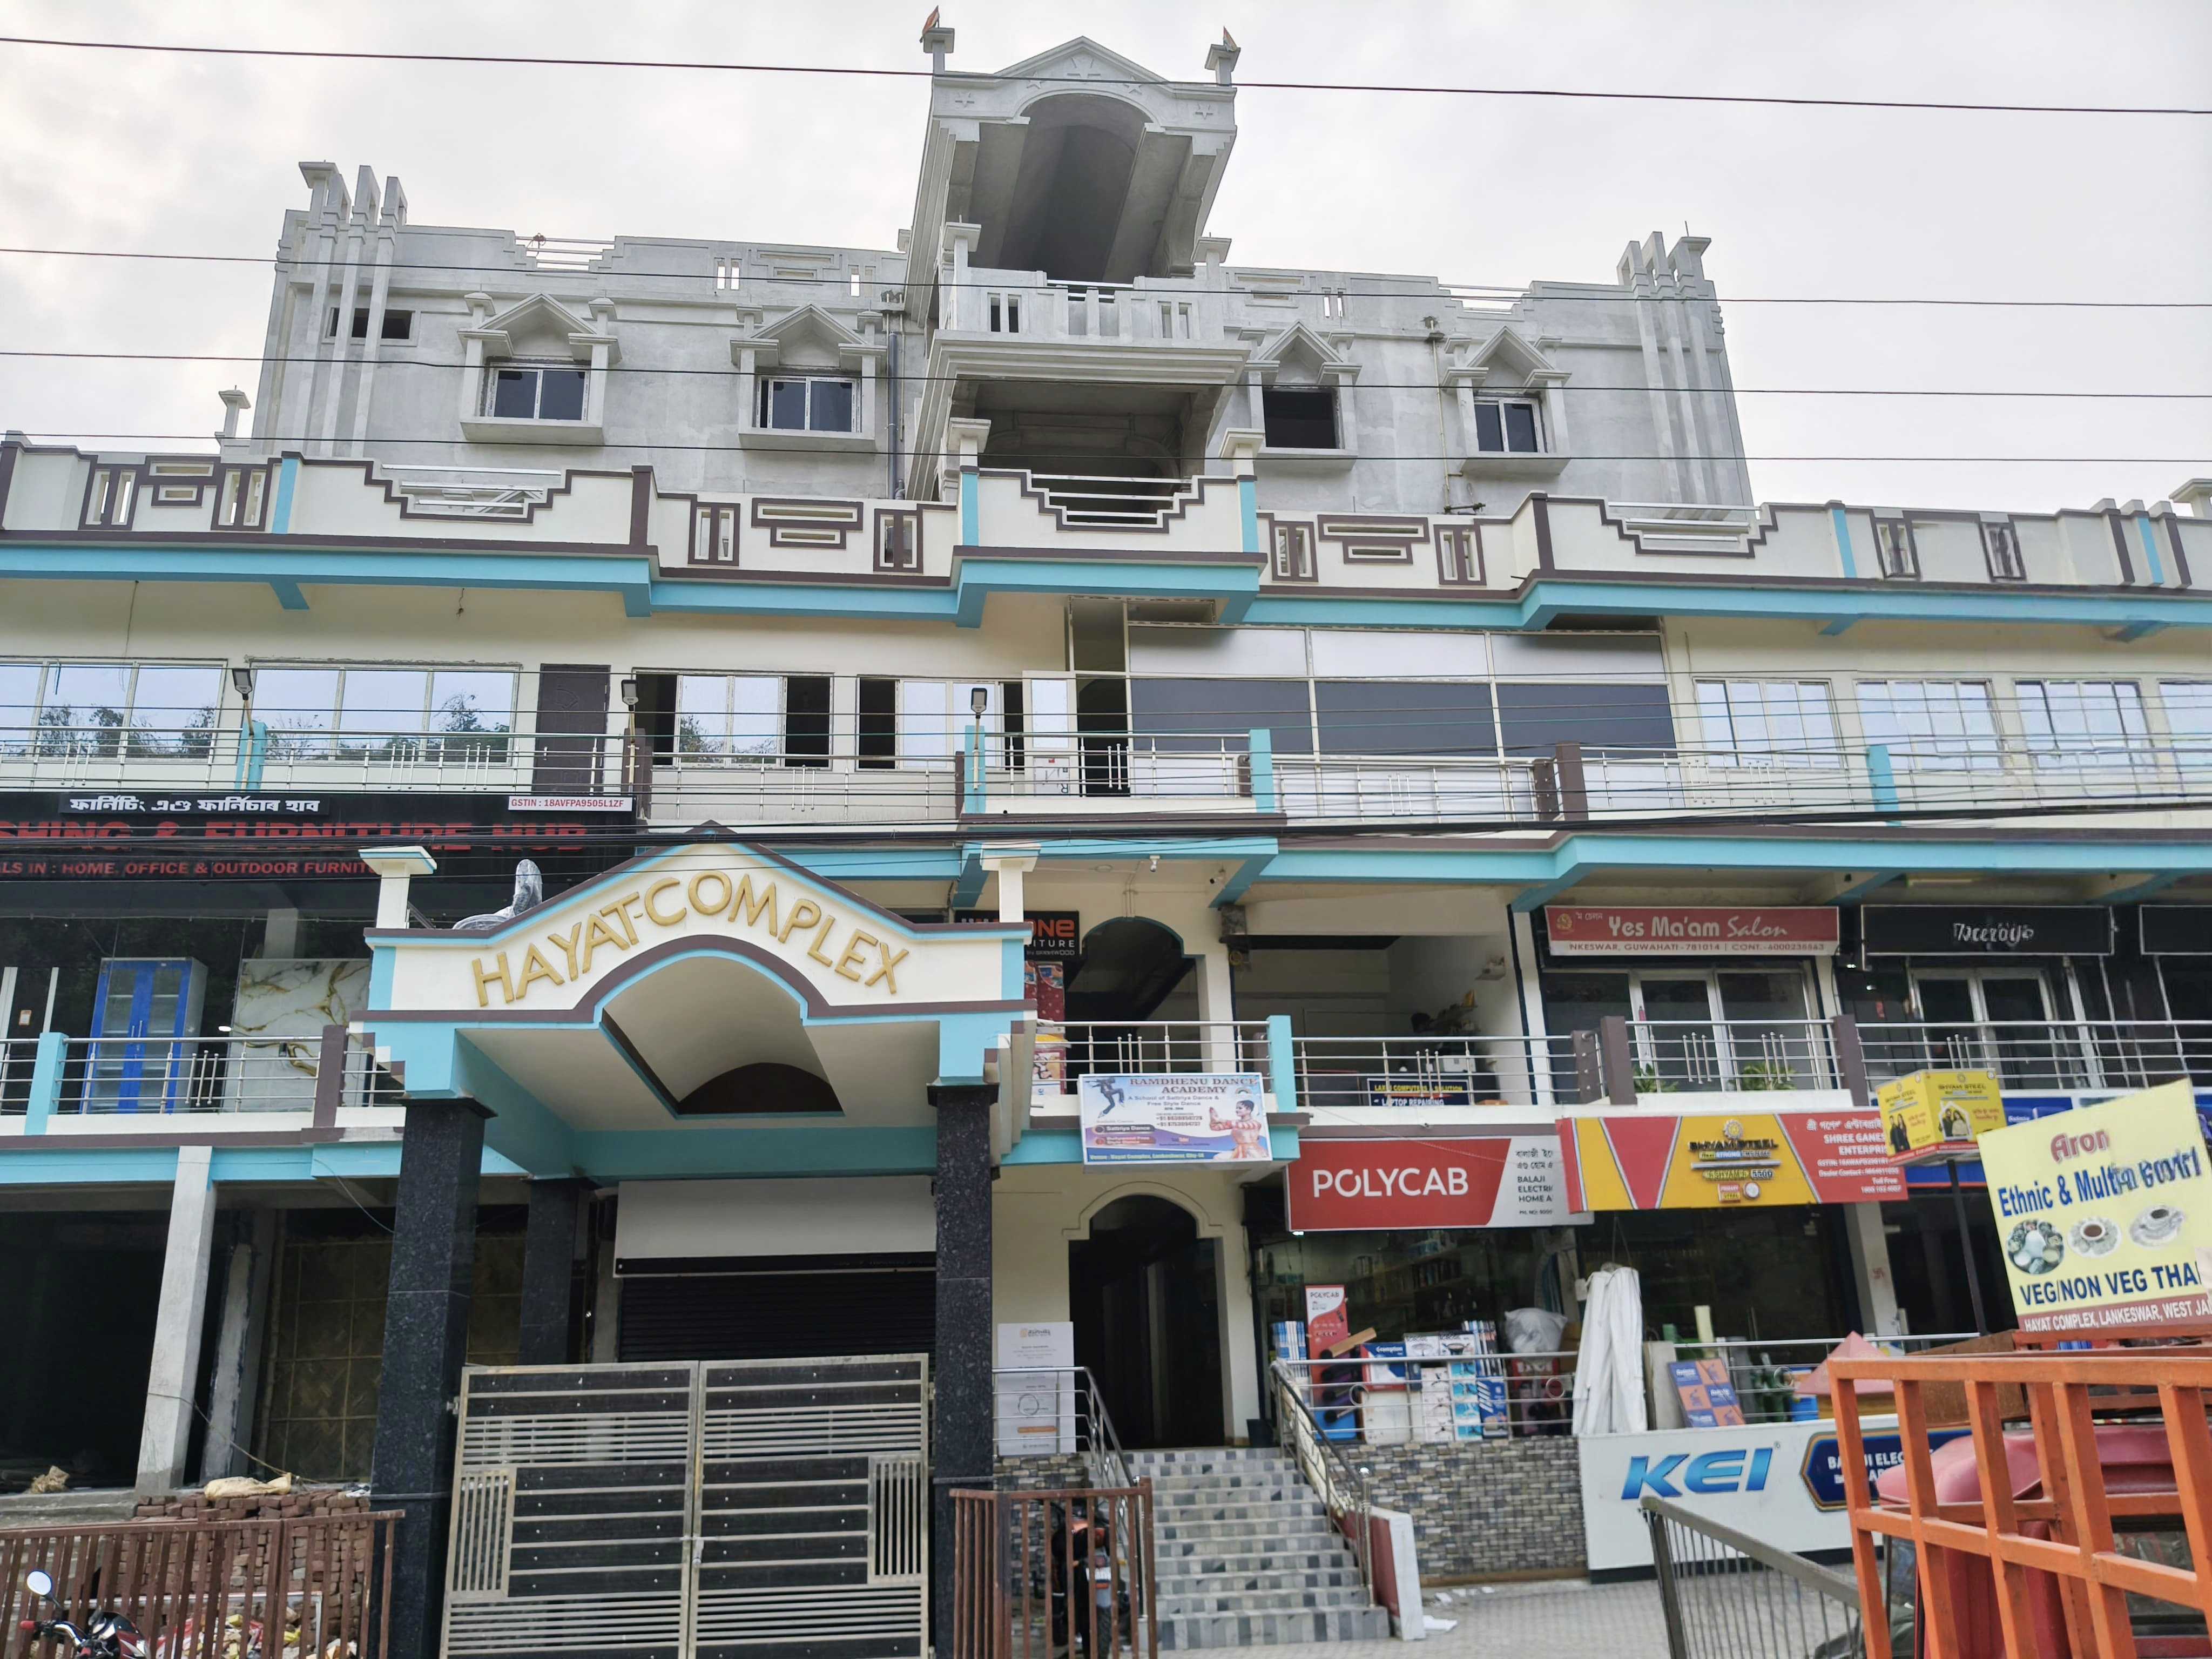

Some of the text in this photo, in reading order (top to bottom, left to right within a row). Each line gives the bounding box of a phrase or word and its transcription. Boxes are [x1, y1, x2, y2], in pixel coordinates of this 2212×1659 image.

[285, 800, 320, 812] হাব
[511, 799, 537, 807] GSTIN
[28, 862, 46, 874] IN
[125, 862, 188, 874] OFFICE
[193, 862, 208, 874] &
[213, 862, 298, 874] OUTDOOR
[1031, 919, 1075, 938] NE
[1608, 915, 1788, 938] Yes Ma'am Salon
[1027, 939, 1075, 948] ITURE
[1212, 1077, 1258, 1085] DANCE
[1823, 1134, 1856, 1144] SHREE
[1312, 1167, 1469, 1198] POLYCAB
[1517, 1175, 1546, 1183] BALAJI
[1519, 1195, 1545, 1203] HOME
[1998, 1180, 2053, 1217] Ethnic
[2056, 1175, 2073, 1205] &
[2105, 1269, 2148, 1296] VEG
[2150, 1261, 2202, 1289] THA
[2024, 1317, 2053, 1333] HAYAT
[2162, 1300, 2191, 1319] WEST
[1621, 1447, 1773, 1500] KEI
